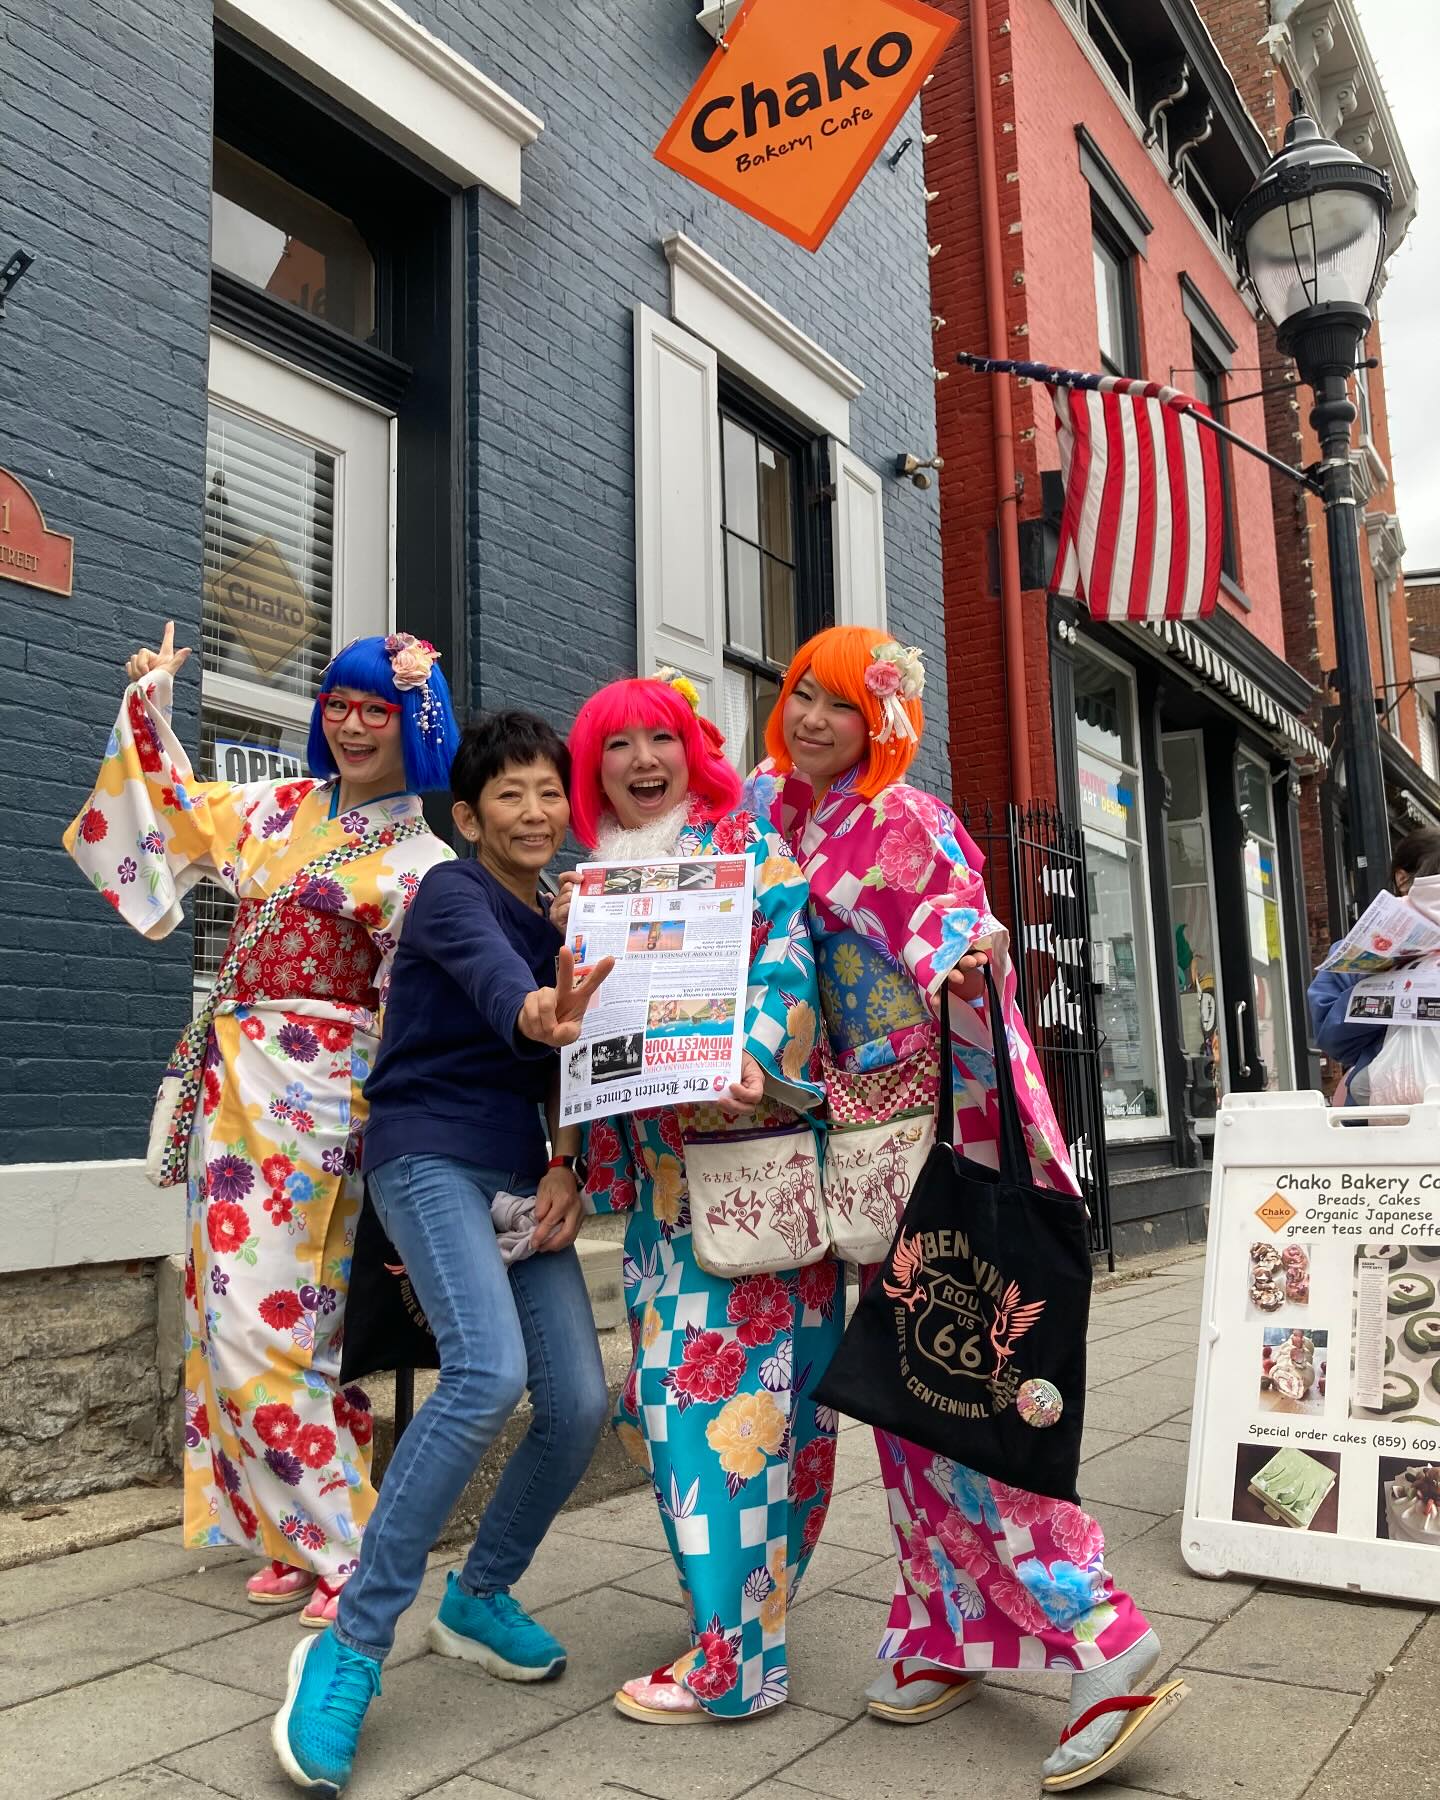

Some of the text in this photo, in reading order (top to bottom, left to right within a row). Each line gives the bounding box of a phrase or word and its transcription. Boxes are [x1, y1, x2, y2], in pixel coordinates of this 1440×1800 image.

[690, 31, 913, 154] Chako
[735, 106, 873, 173] Bakery Cafe
[228, 581, 305, 626] Chako
[225, 747, 303, 783] OPEN
[644, 1037, 733, 1053] MIDWEST TOUR
[644, 1050, 732, 1066] BENTENYA
[635, 1079, 680, 1097] Benten
[683, 1077, 709, 1092] The
[596, 1088, 632, 1105] Times
[1276, 1174, 1332, 1190] Chako
[1341, 1173, 1410, 1194] Bakery
[1318, 1194, 1421, 1207] Breads, Cakes
[1261, 1208, 1291, 1216] Chako
[1305, 1208, 1433, 1224] Organic Japanese
[1287, 1225, 1326, 1237] green
[1331, 1224, 1362, 1235] teas
[1369, 1224, 1394, 1235] and
[942, 1285, 980, 1310] ROU
[957, 1313, 975, 1331] US
[933, 1323, 982, 1369] 66
[894, 1306, 907, 1353] ROUTE
[906, 1375, 990, 1419] CENTENNIAL
[1248, 1424, 1290, 1439] Special
[1295, 1429, 1328, 1441] order
[1333, 1432, 1367, 1445] cakes
[1372, 1435, 1407, 1450] (859)
